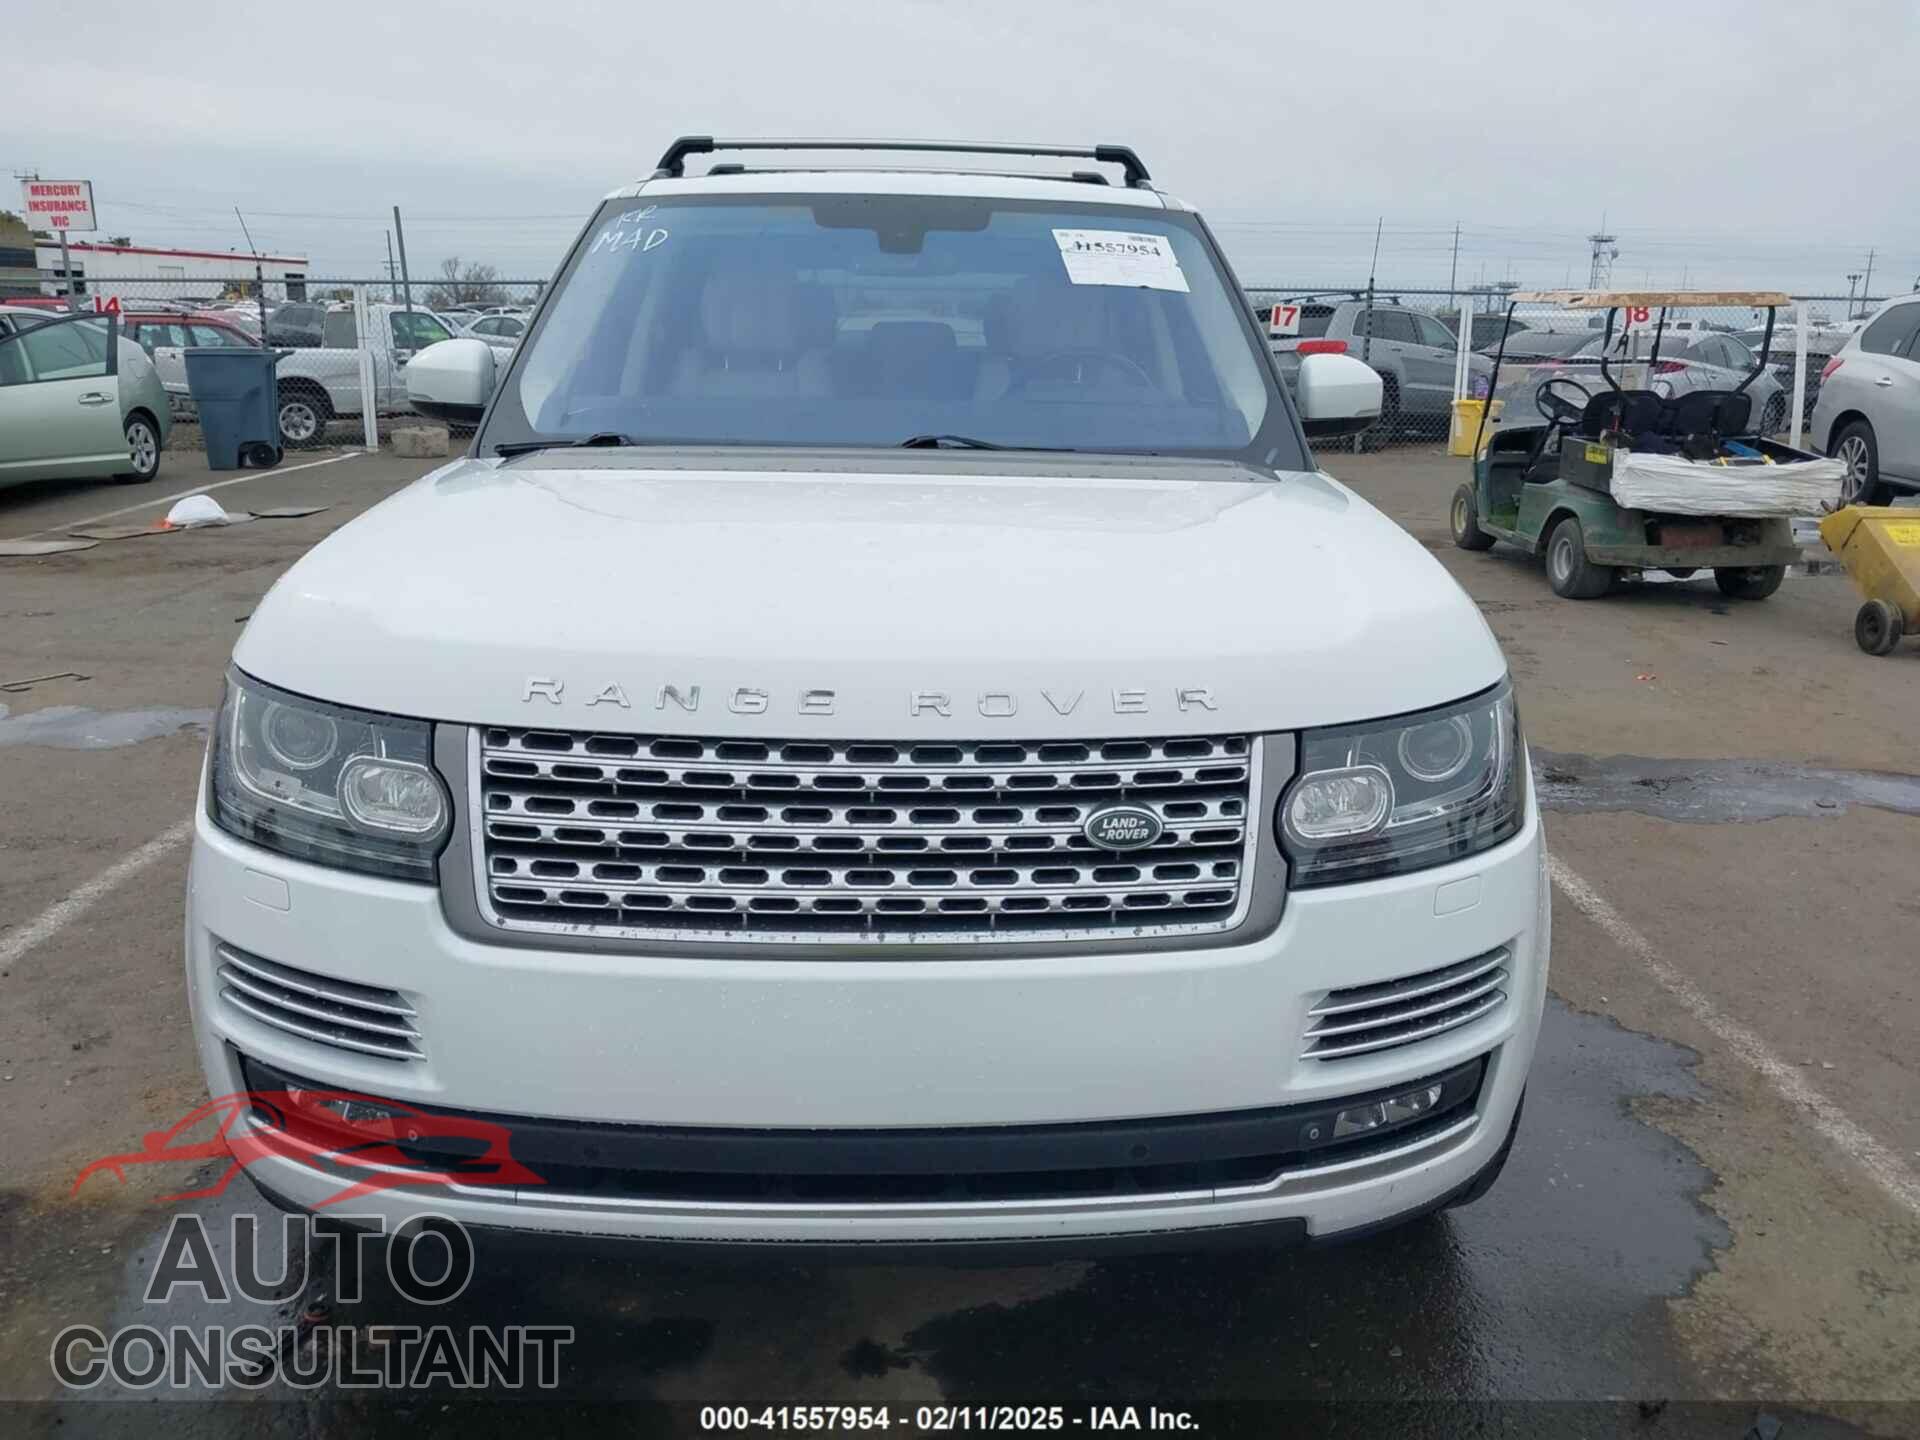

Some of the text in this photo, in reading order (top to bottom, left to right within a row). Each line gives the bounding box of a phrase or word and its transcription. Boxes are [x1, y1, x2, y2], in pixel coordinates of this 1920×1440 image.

[31, 185, 80, 196] MERCURY
[29, 200, 88, 212] INSURANCE
[51, 215, 69, 227] VIC
[591, 227, 668, 254] MAD
[1273, 306, 1297, 326] 17
[522, 676, 1219, 717] RANGE ROVER
